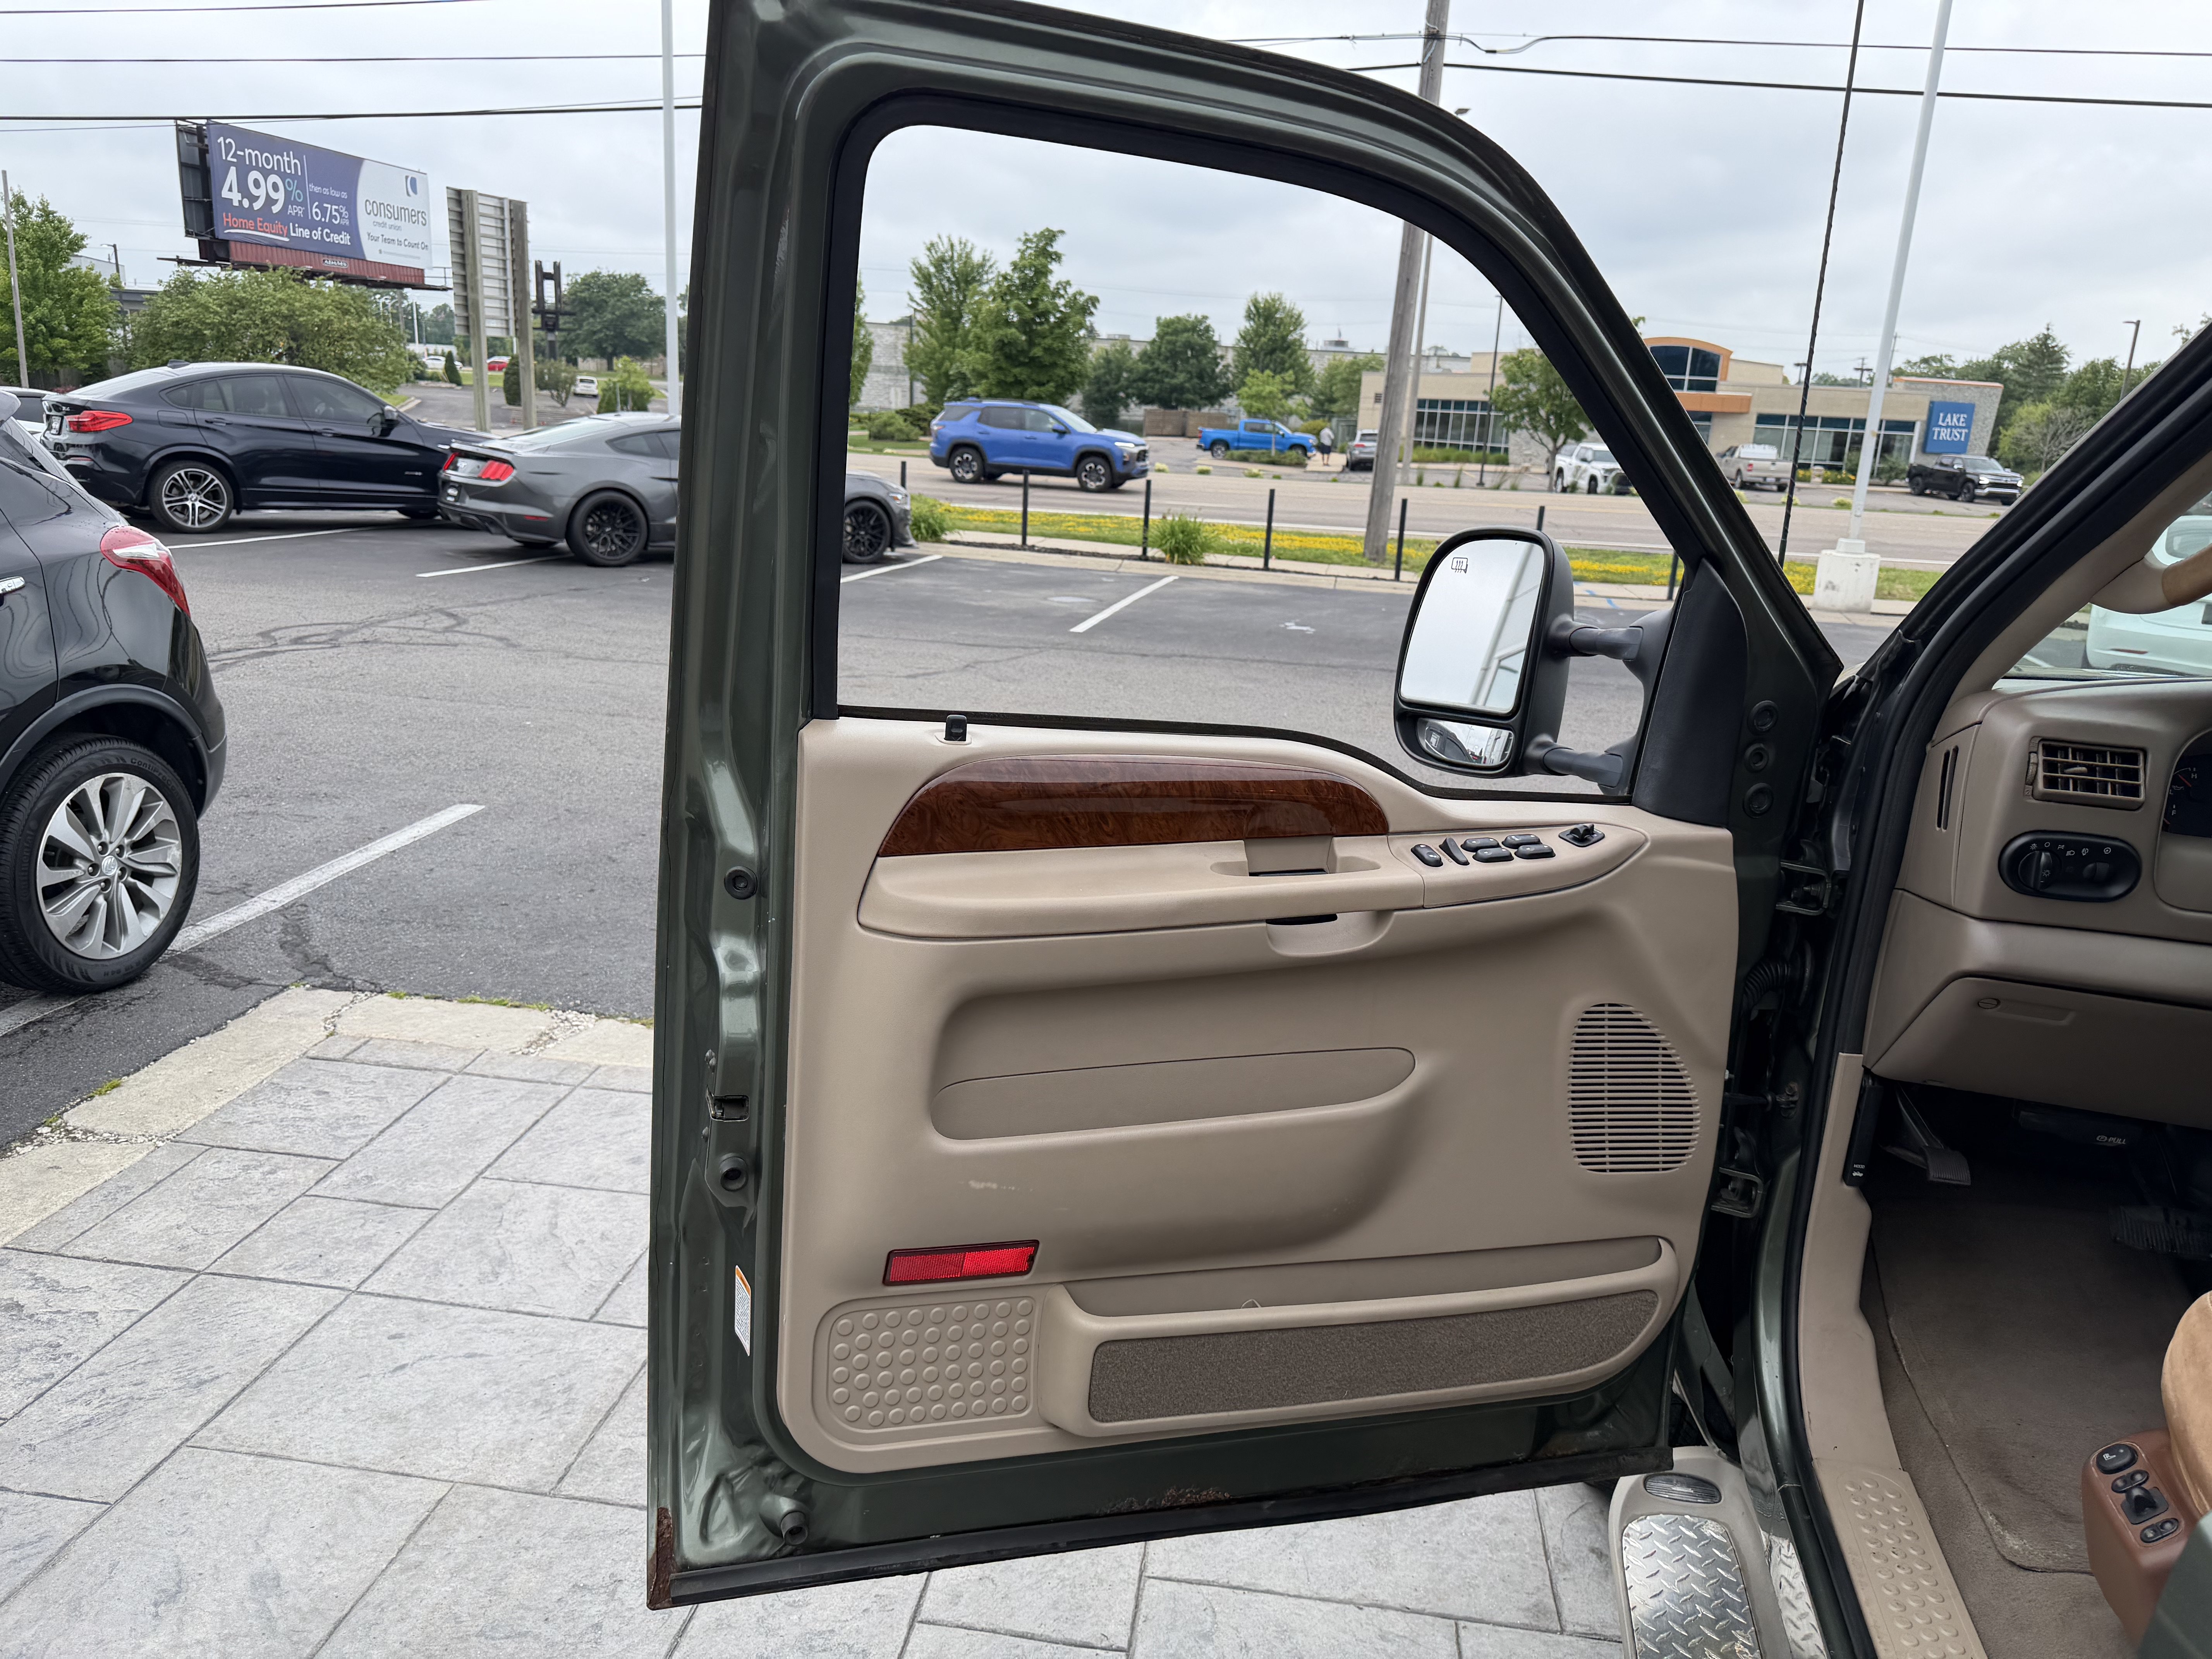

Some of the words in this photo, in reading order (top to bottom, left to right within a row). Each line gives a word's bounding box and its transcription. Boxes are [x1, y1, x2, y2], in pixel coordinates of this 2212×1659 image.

[217, 136, 301, 175] 12-month
[309, 183, 322, 193] then
[330, 187, 340, 197] low
[365, 199, 427, 226] consumers
[223, 212, 254, 230] Home
[257, 217, 288, 237] Equity
[290, 223, 310, 238] Line
[312, 227, 322, 240] of
[323, 228, 351, 245] Credit
[373, 220, 387, 229] credit
[388, 223, 402, 231] union
[367, 232, 380, 242] Your
[381, 234, 396, 246] Team
[397, 238, 402, 246] to
[404, 239, 419, 249] Count
[421, 242, 428, 251] On
[1938, 412, 1967, 426] LAKE
[1932, 427, 1968, 441] TRUST
